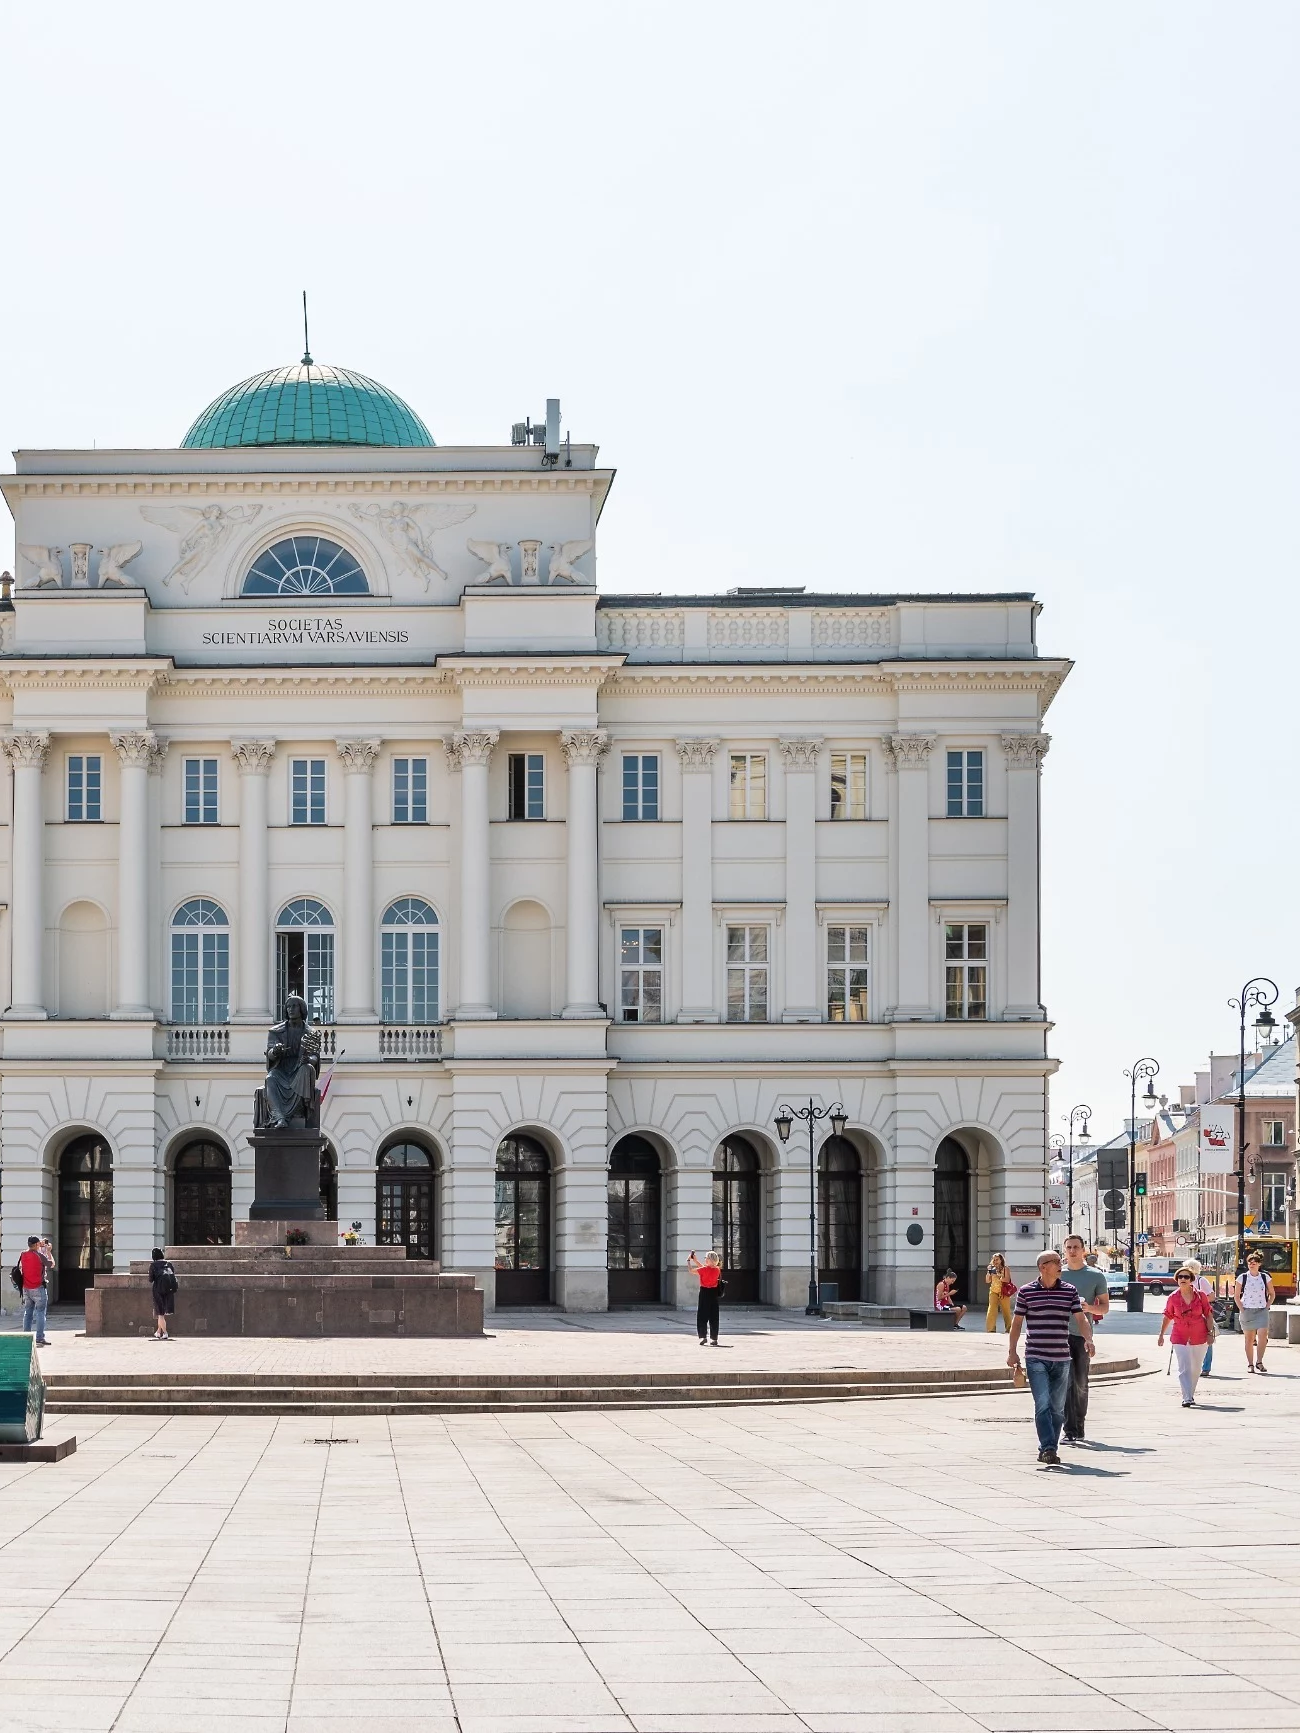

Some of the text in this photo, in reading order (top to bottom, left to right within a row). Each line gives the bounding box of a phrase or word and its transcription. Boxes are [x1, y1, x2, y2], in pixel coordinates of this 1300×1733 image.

[268, 618, 343, 631] SOCIETAS
[202, 630, 409, 645] SCIENTIARVM VARSAVIENSIS
